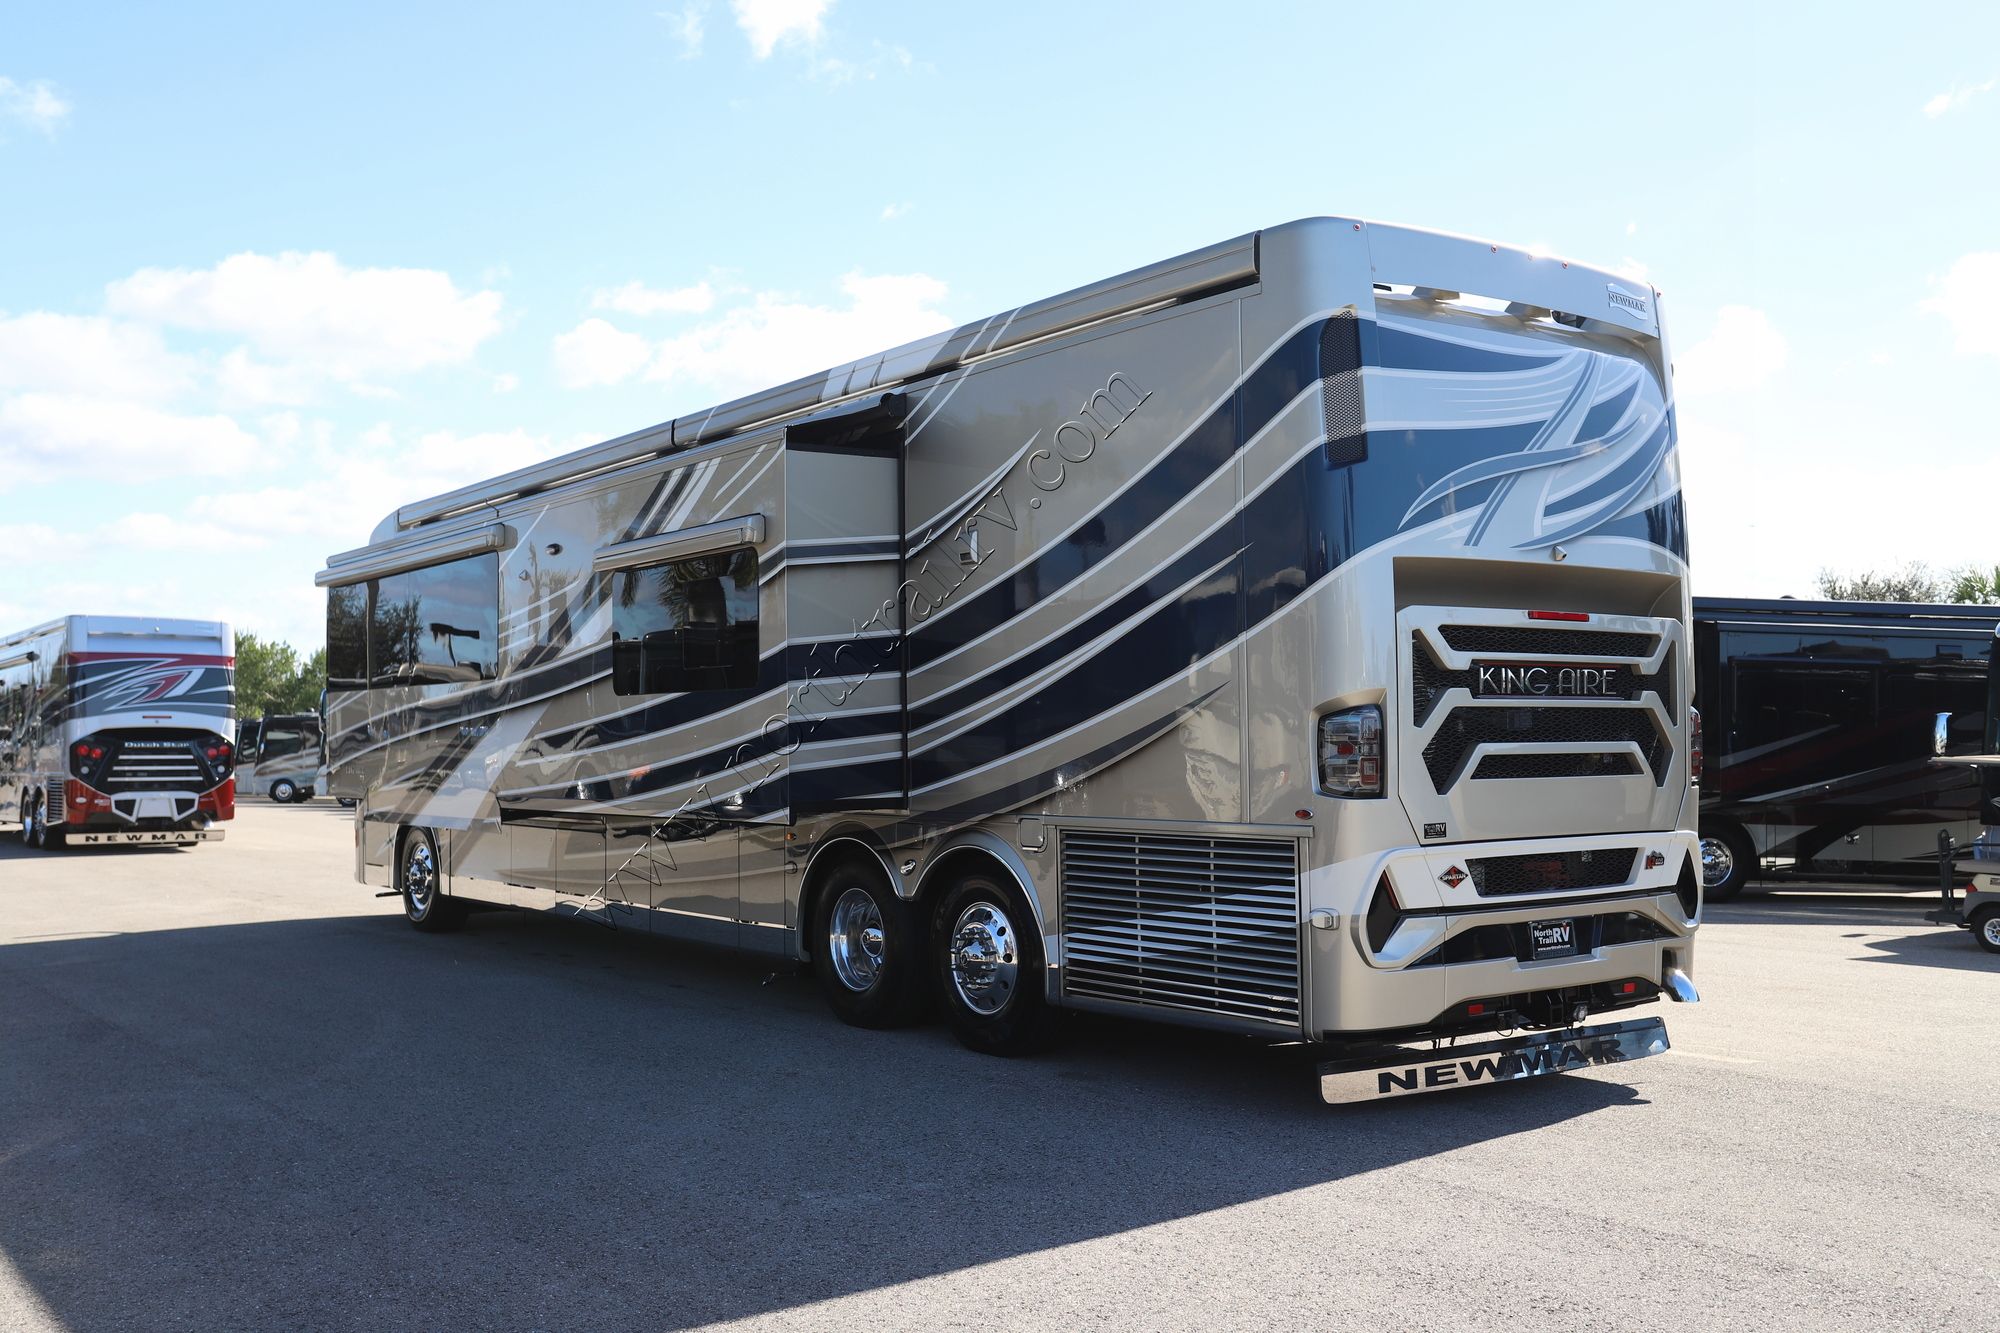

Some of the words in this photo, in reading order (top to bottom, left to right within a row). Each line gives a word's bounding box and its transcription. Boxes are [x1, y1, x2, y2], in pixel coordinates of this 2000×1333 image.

[1608, 292, 1646, 313] NEWMAR
[1479, 667, 1550, 695] KING
[1556, 668, 1617, 695] AIRE
[85, 832, 208, 842] NEWMAR
[1534, 929, 1553, 938] North
[1553, 926, 1570, 942] RV
[1538, 936, 1553, 944] Trail
[1378, 1039, 1626, 1094] NEWMAR
